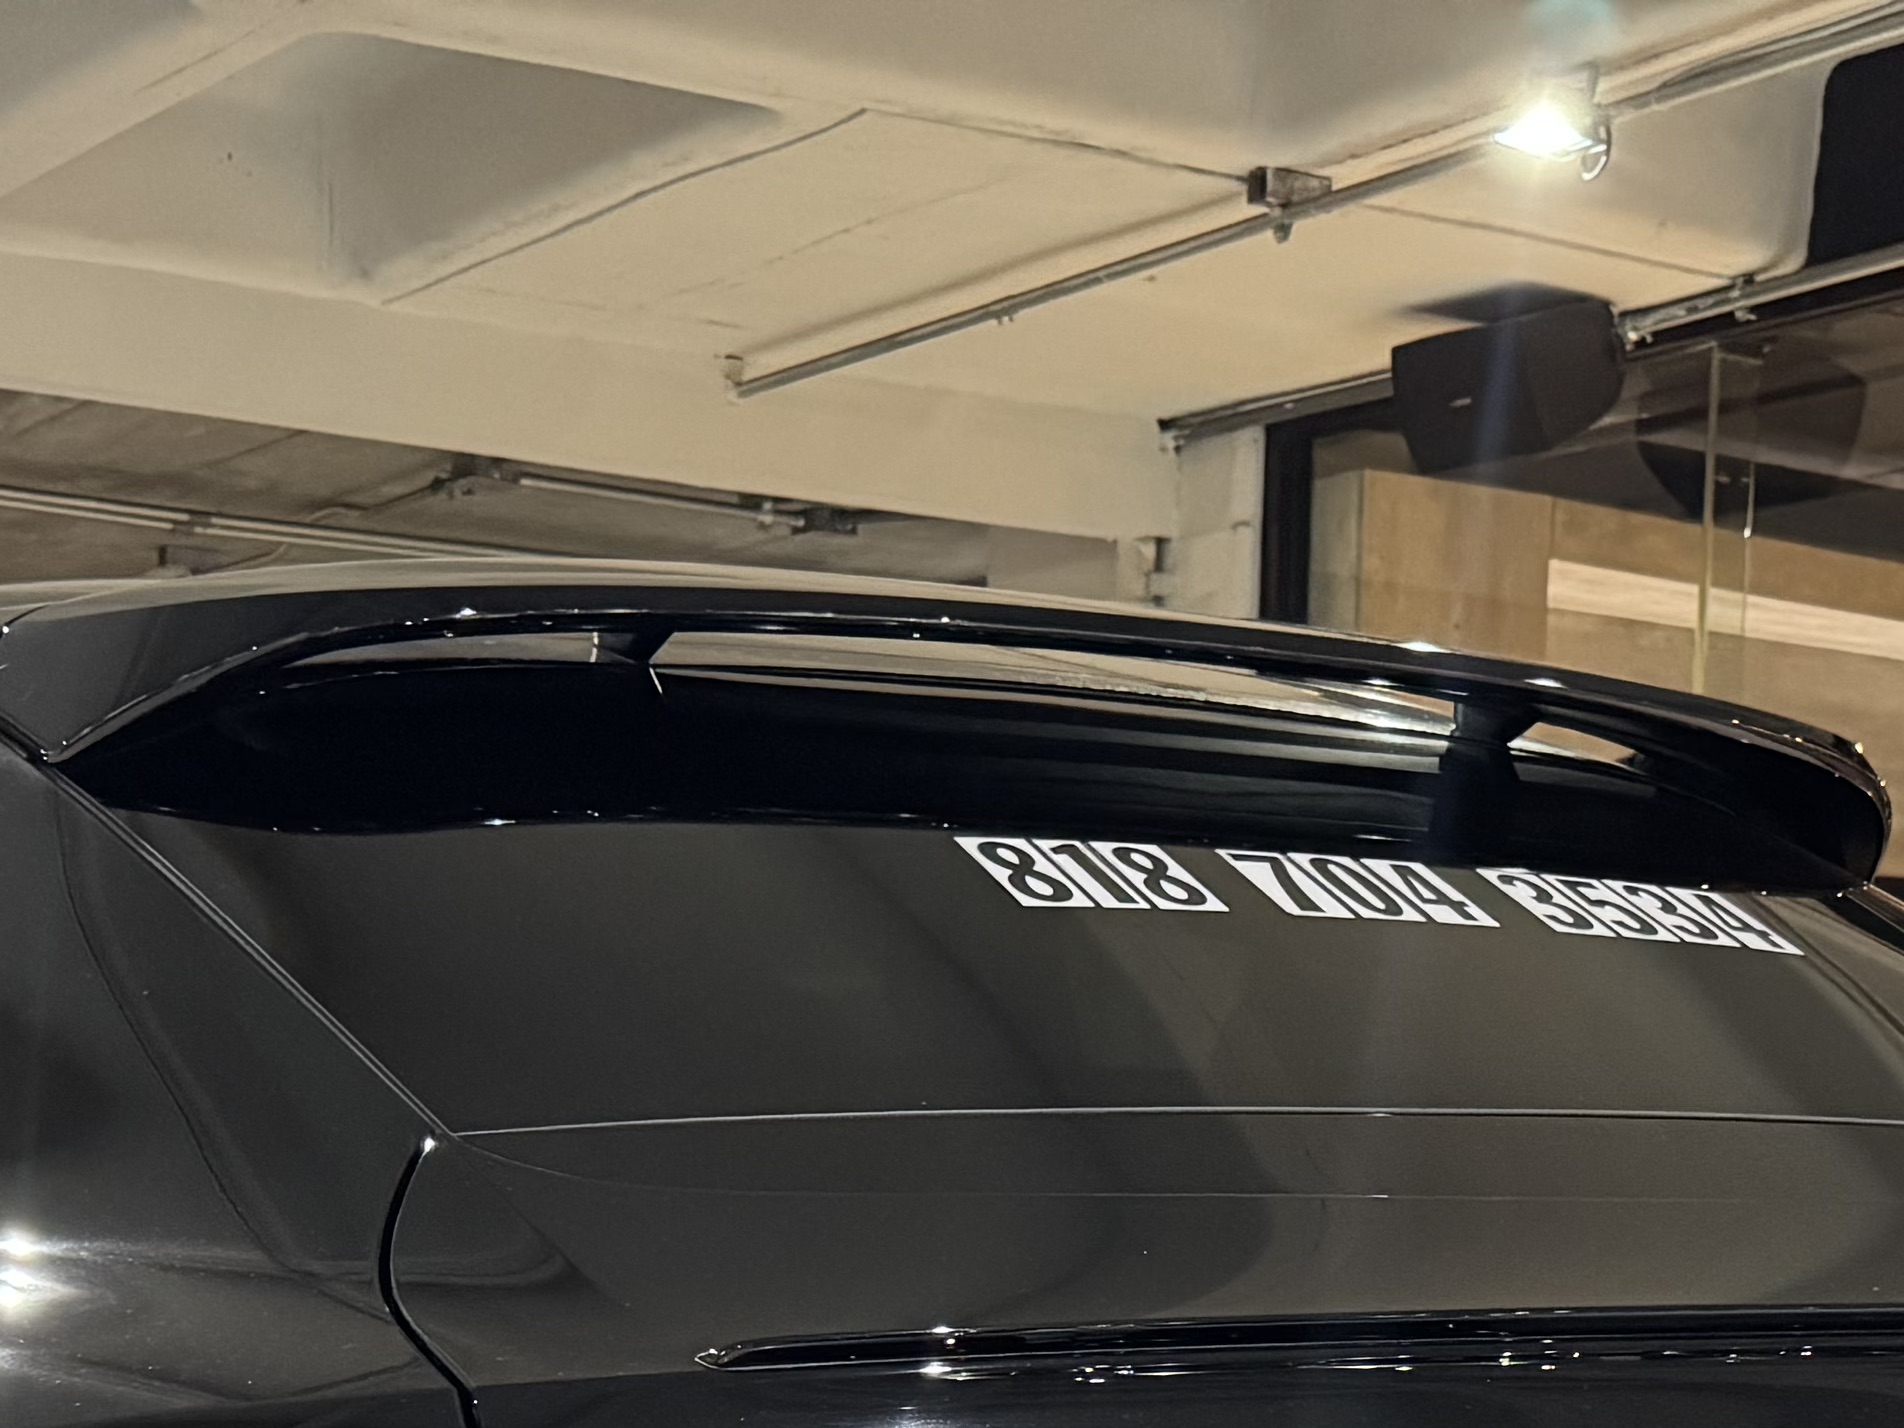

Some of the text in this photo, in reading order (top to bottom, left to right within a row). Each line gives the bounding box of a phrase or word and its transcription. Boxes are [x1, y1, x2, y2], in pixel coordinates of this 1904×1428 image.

[977, 841, 1785, 949] 818 704 3534
